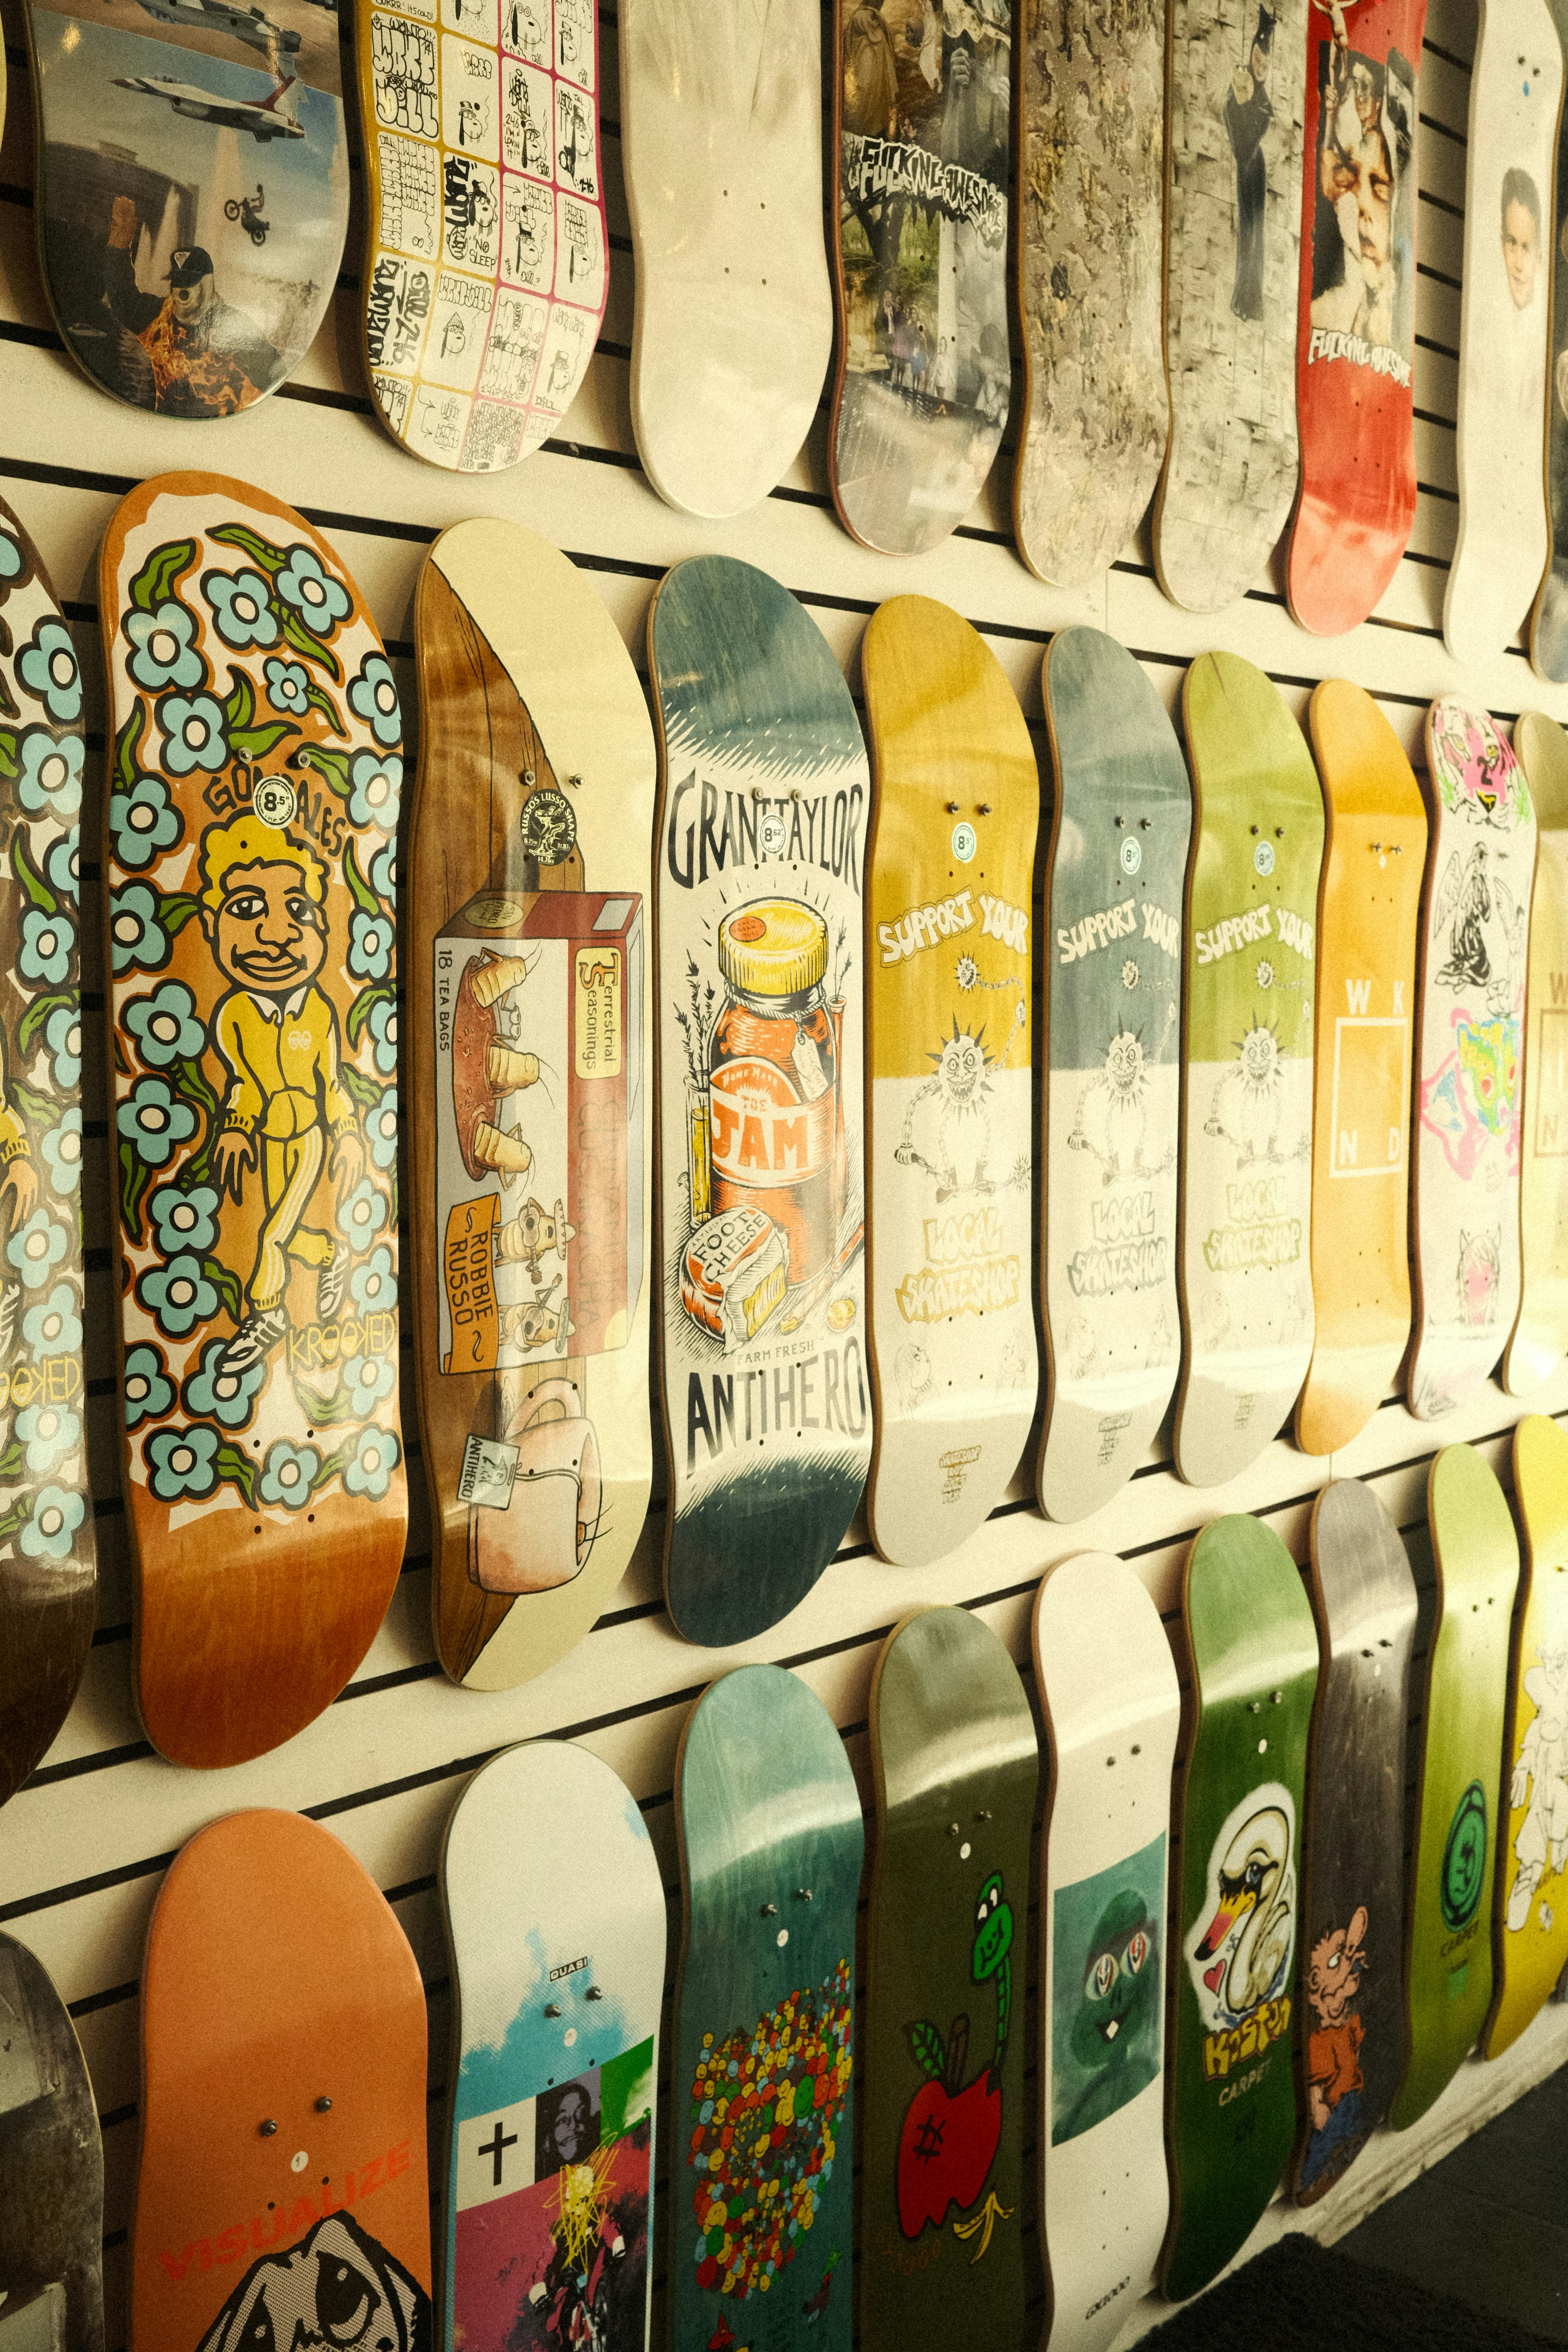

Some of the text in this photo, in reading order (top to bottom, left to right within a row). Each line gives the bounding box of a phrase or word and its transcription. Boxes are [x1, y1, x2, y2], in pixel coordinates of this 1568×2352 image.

[202, 762, 346, 857] GOALES
[564, 808, 575, 843] SHAPE
[774, 783, 864, 898] TAYLOR
[487, 901, 506, 924] PEDRO
[879, 890, 1028, 964] SUPPORT YOUR
[1057, 898, 1179, 964] SUPPORT YOUR
[1195, 903, 1314, 965] SUPPORT YOUR
[438, 949, 453, 1052] 18 TEA BAGS
[578, 960, 604, 1072] Seasonings
[599, 952, 620, 1064] Terrestrial
[711, 1098, 810, 1171] JAM
[741, 1094, 767, 1112] TOE
[692, 1211, 749, 1263] FOOT
[704, 1214, 767, 1282] CHEESE
[923, 1206, 1003, 1266] LOCAL
[1090, 1191, 1155, 1244] LOCAL
[449, 1240, 473, 1326] RUSSO
[469, 1230, 494, 1323] ROBBIE
[894, 1255, 1021, 1325] SKATESHOP
[1066, 1236, 1167, 1297] SKATESHOP
[289, 1311, 395, 1371] KROOKED
[737, 1340, 815, 1365] FARM FRESH
[686, 1335, 867, 1480] ANTIHERO
[460, 1436, 484, 1499] ANTIHERO
[550, 1957, 588, 1982] QUASI
[158, 2139, 411, 2283] VISUALIZE
